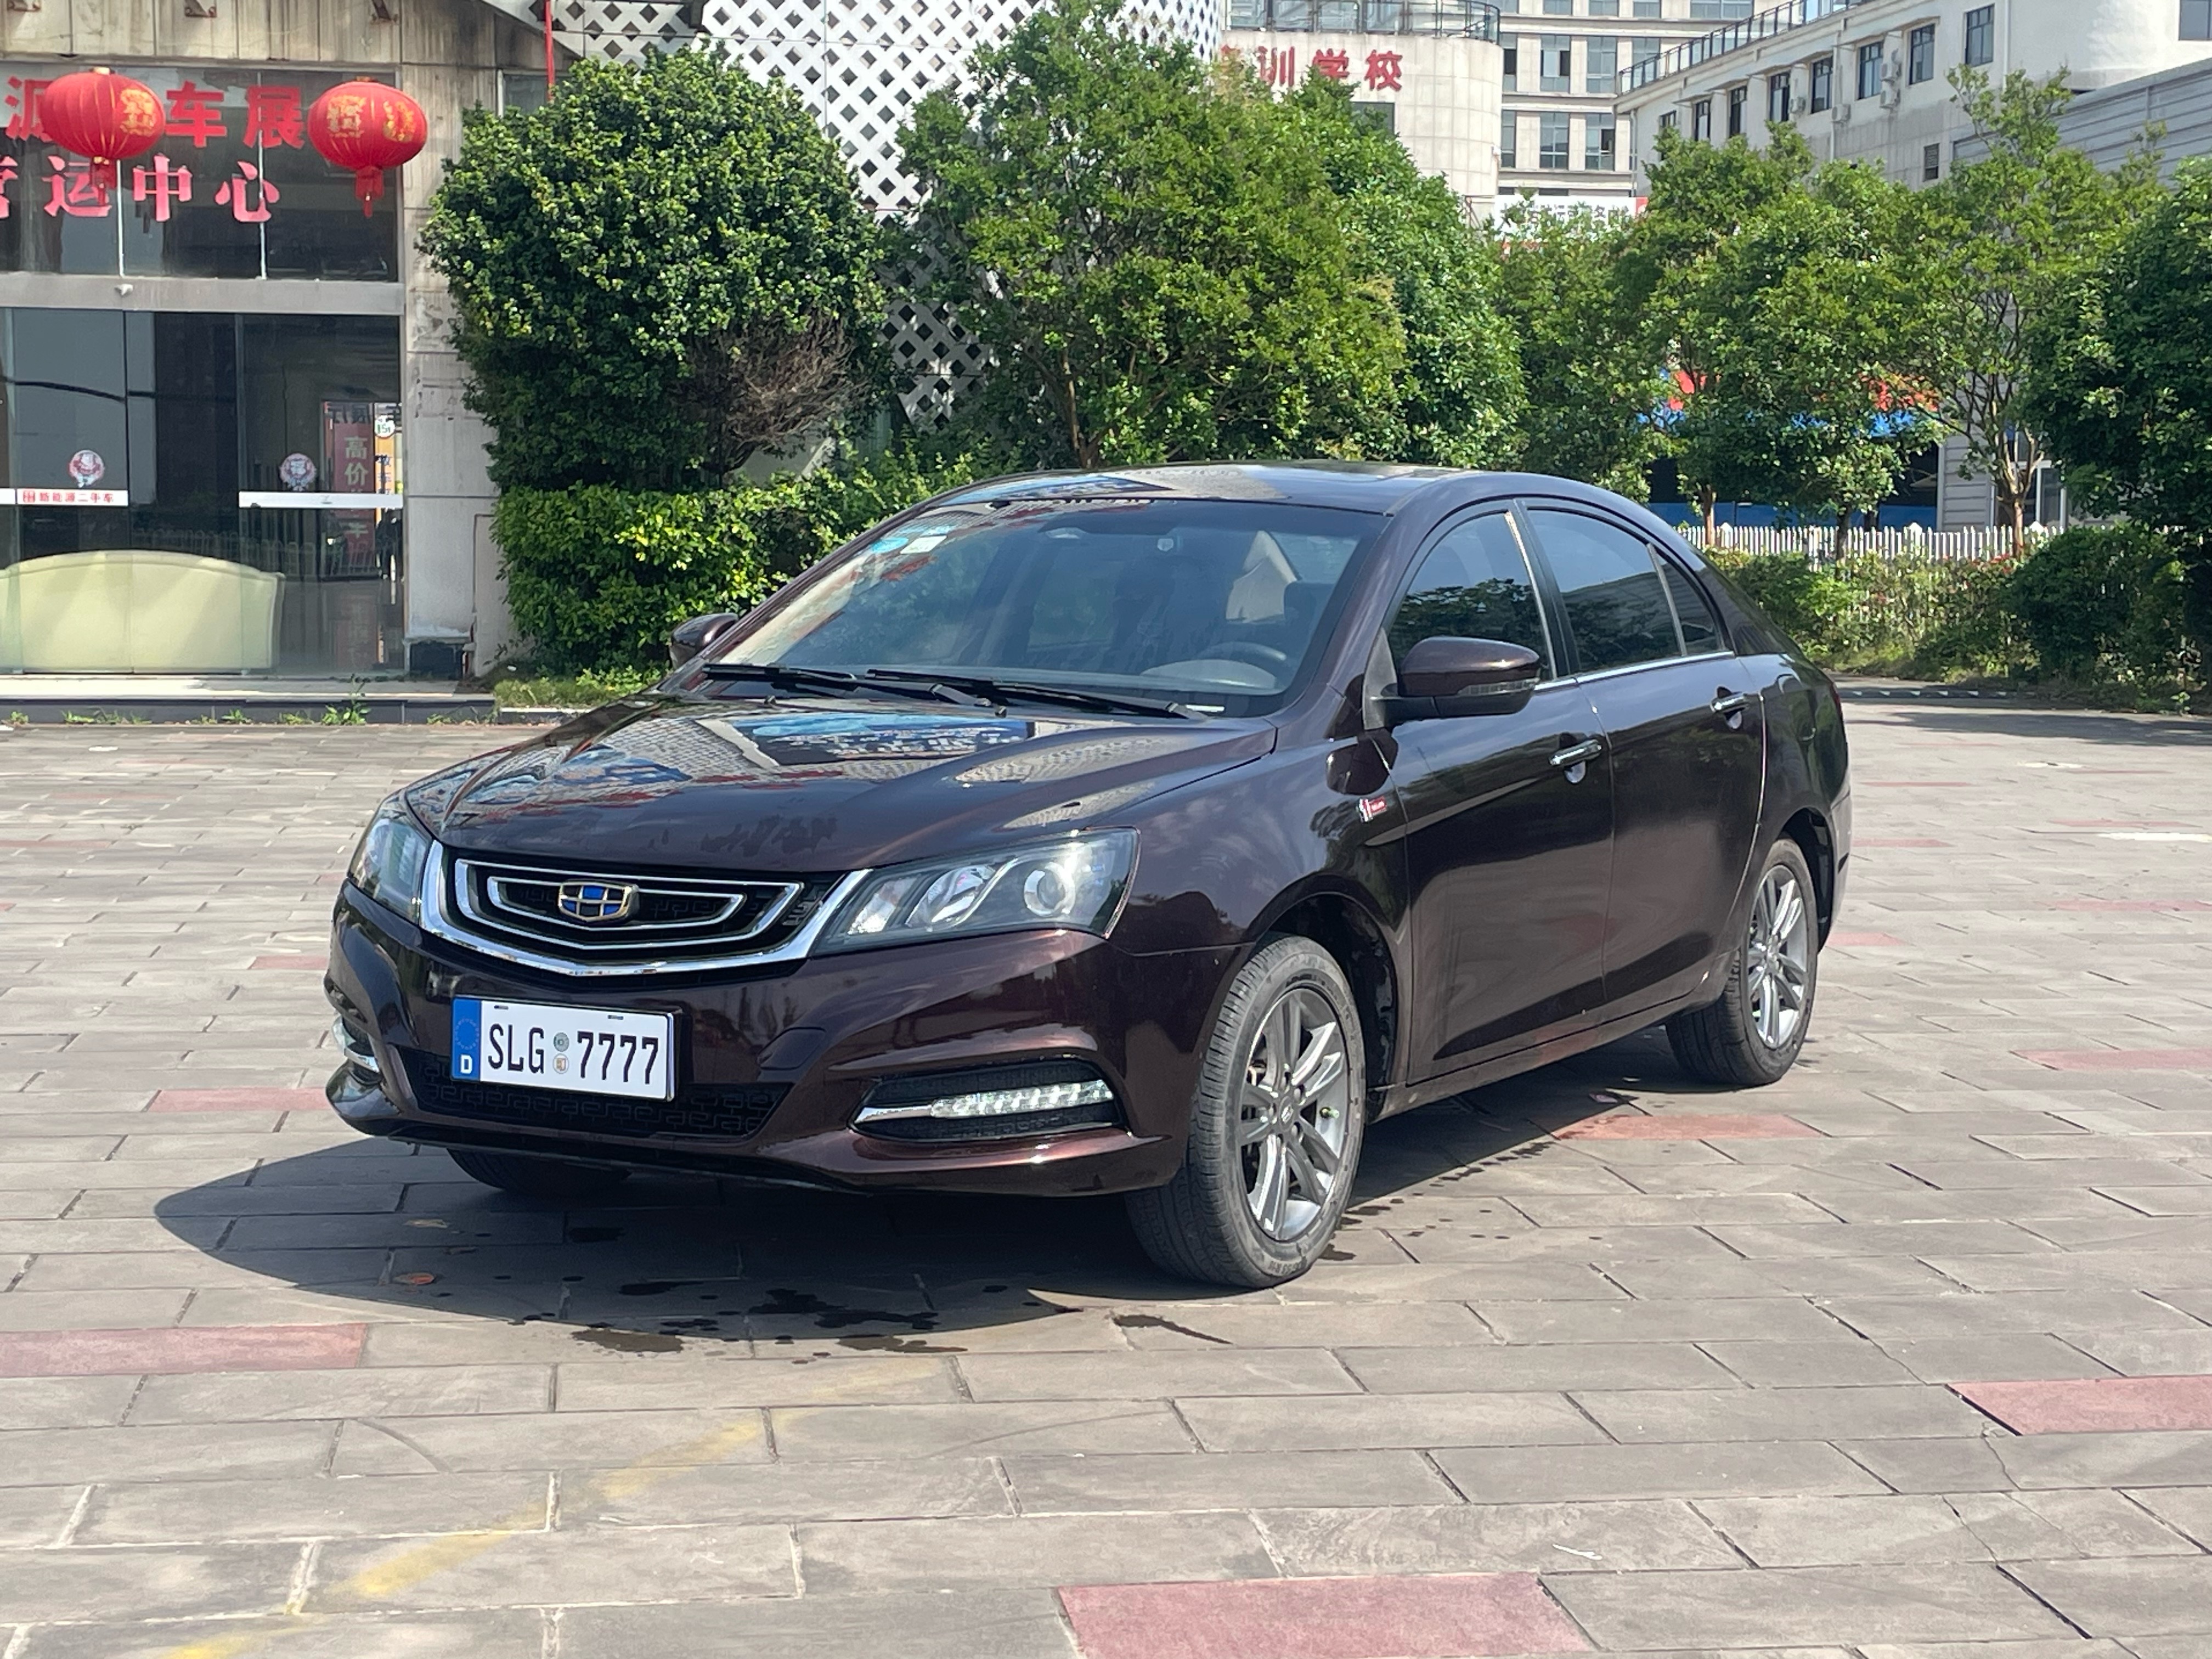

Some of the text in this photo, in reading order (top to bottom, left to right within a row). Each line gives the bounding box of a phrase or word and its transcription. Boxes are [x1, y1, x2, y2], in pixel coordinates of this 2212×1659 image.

[1221, 44, 1403, 92] 训学校
[460, 1054, 473, 1074] D
[488, 1023, 659, 1085] SLG 7777
